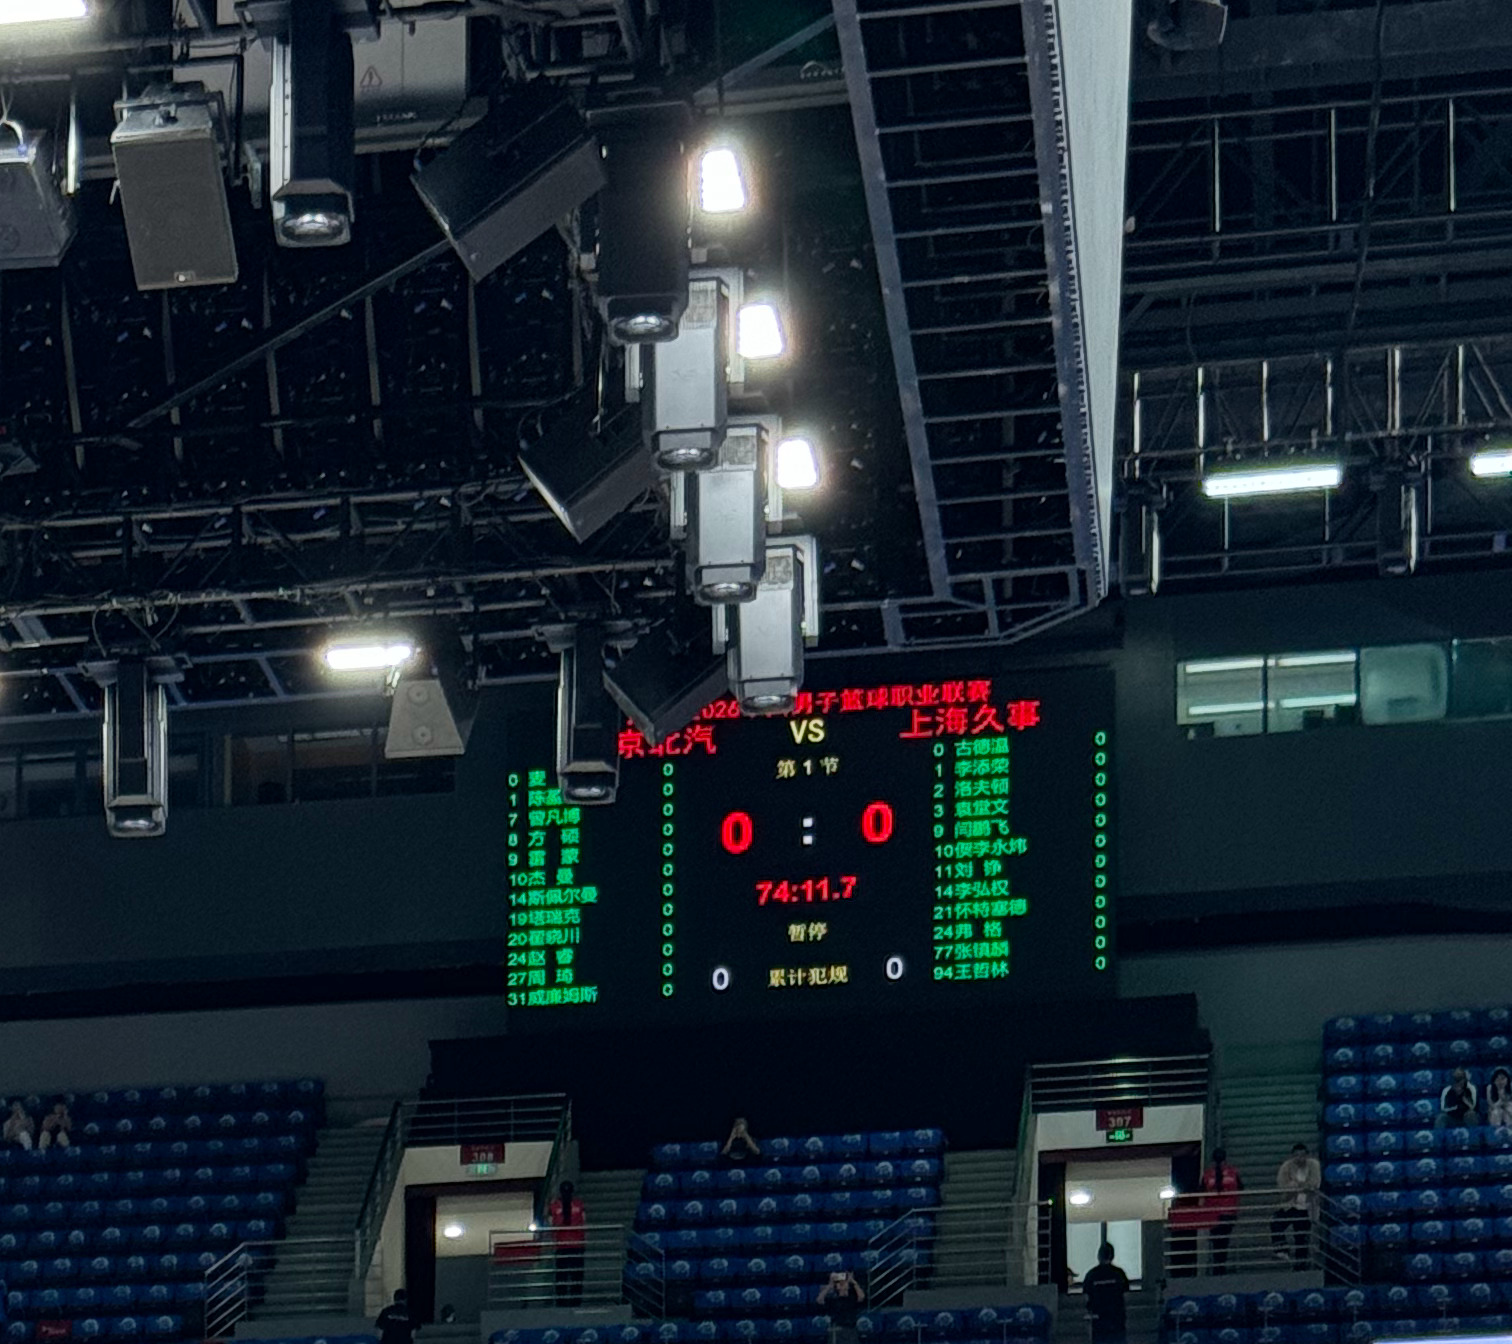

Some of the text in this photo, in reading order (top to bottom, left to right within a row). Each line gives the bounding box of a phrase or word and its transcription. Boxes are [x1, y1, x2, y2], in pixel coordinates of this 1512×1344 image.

[790, 719, 825, 744] VS
[899, 701, 1040, 739] 上海久事
[954, 737, 1009, 757] 古德温
[722, 811, 753, 854] 0
[862, 801, 893, 843] 0
[756, 876, 857, 906] 74:11.7
[788, 922, 827, 942] 暂停
[712, 968, 729, 990] 0
[768, 965, 848, 988] 累计犯规
[886, 957, 903, 979] 0
[954, 961, 1009, 980] 王哲林
